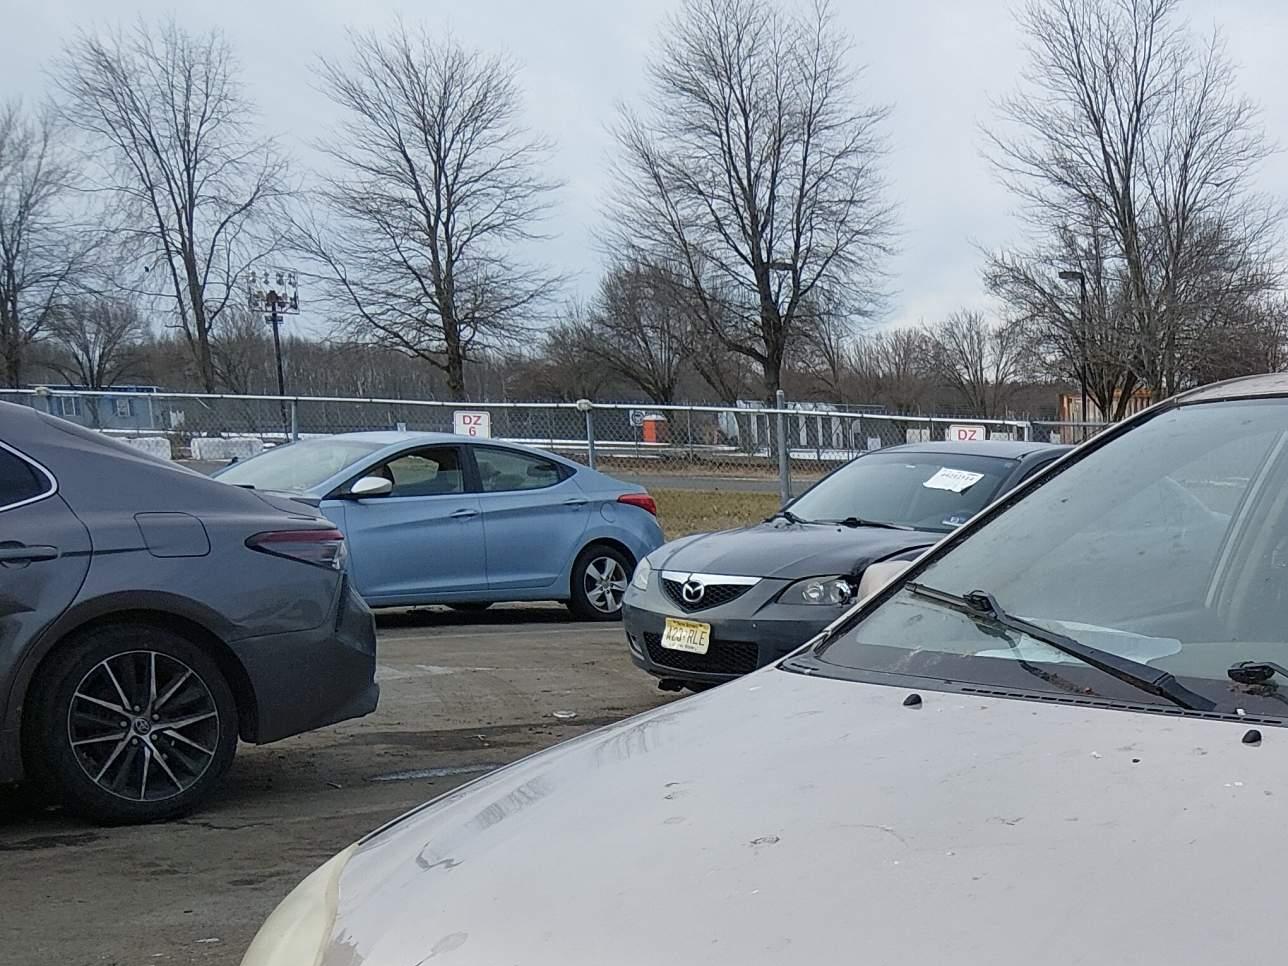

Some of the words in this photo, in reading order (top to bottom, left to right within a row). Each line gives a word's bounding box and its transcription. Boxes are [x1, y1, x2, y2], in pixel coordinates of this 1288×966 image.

[463, 415, 482, 425] DZ
[469, 426, 477, 437] 6
[958, 429, 977, 440] DZ
